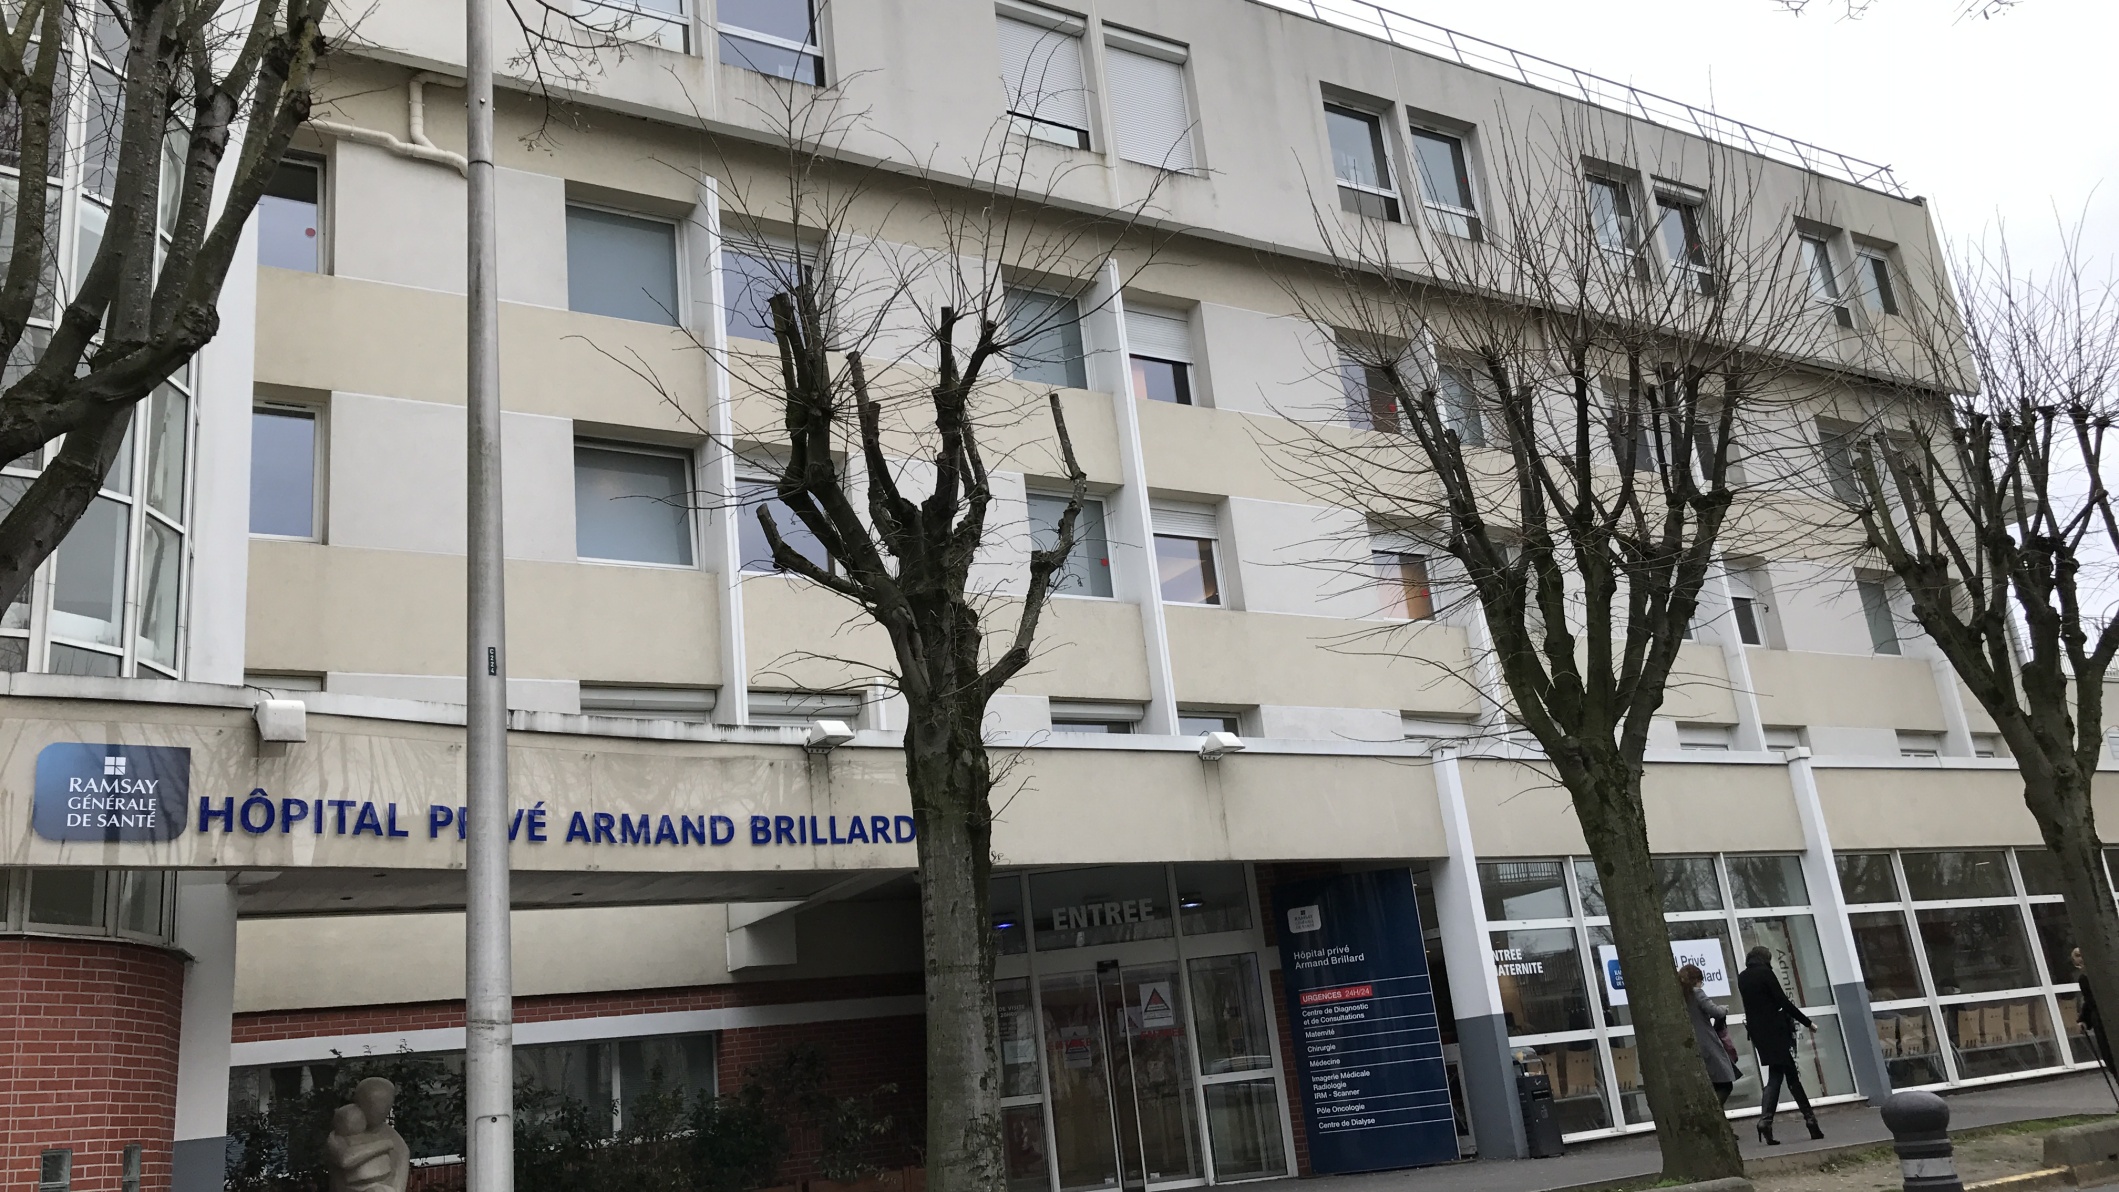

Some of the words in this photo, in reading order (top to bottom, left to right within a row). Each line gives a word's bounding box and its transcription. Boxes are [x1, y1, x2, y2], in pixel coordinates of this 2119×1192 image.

[69, 777, 159, 794] RAMSAY
[67, 794, 156, 811] GÉNÉRALE
[66, 813, 92, 827] DE
[96, 811, 156, 828] SANTÉ
[198, 787, 409, 838] HÔPITAL
[430, 801, 547, 842] PVÉ
[565, 811, 735, 845] ARMAND
[750, 815, 917, 845] BRILLARD
[1052, 898, 1155, 931] ENTREE
[1293, 947, 1325, 960] Hôpital
[1327, 944, 1350, 957] privé
[1493, 948, 1523, 962] NTREE
[1295, 957, 1329, 970] Armand
[1331, 952, 1365, 965] Brillard
[1680, 953, 1706, 967] Privé
[1498, 961, 1544, 977] ATERNITE
[1703, 968, 1722, 982] lard
[1302, 991, 1342, 1003] URGENCES
[1345, 987, 1370, 997] 24H/24
[1302, 1009, 1323, 1017] Centre
[1333, 1003, 1369, 1013] Diagnostic
[1320, 1012, 1365, 1024] Consultations
[1305, 1028, 1335, 1038] Maternité
[1307, 1043, 1336, 1053] Chirurgie
[1309, 1058, 1341, 1067] Médecine
[1311, 1073, 1339, 1082] Imagerie
[1340, 1070, 1371, 1079] Médicale
[1313, 1081, 1347, 1091] Radiologie
[1332, 1089, 1360, 1097] Scanner
[1316, 1107, 1331, 1115] Pôle
[1331, 1103, 1365, 1113] Oncologie
[1318, 1121, 1340, 1129] Centre
[1341, 1119, 1350, 1127] de
[1350, 1117, 1376, 1126] Dialyse
